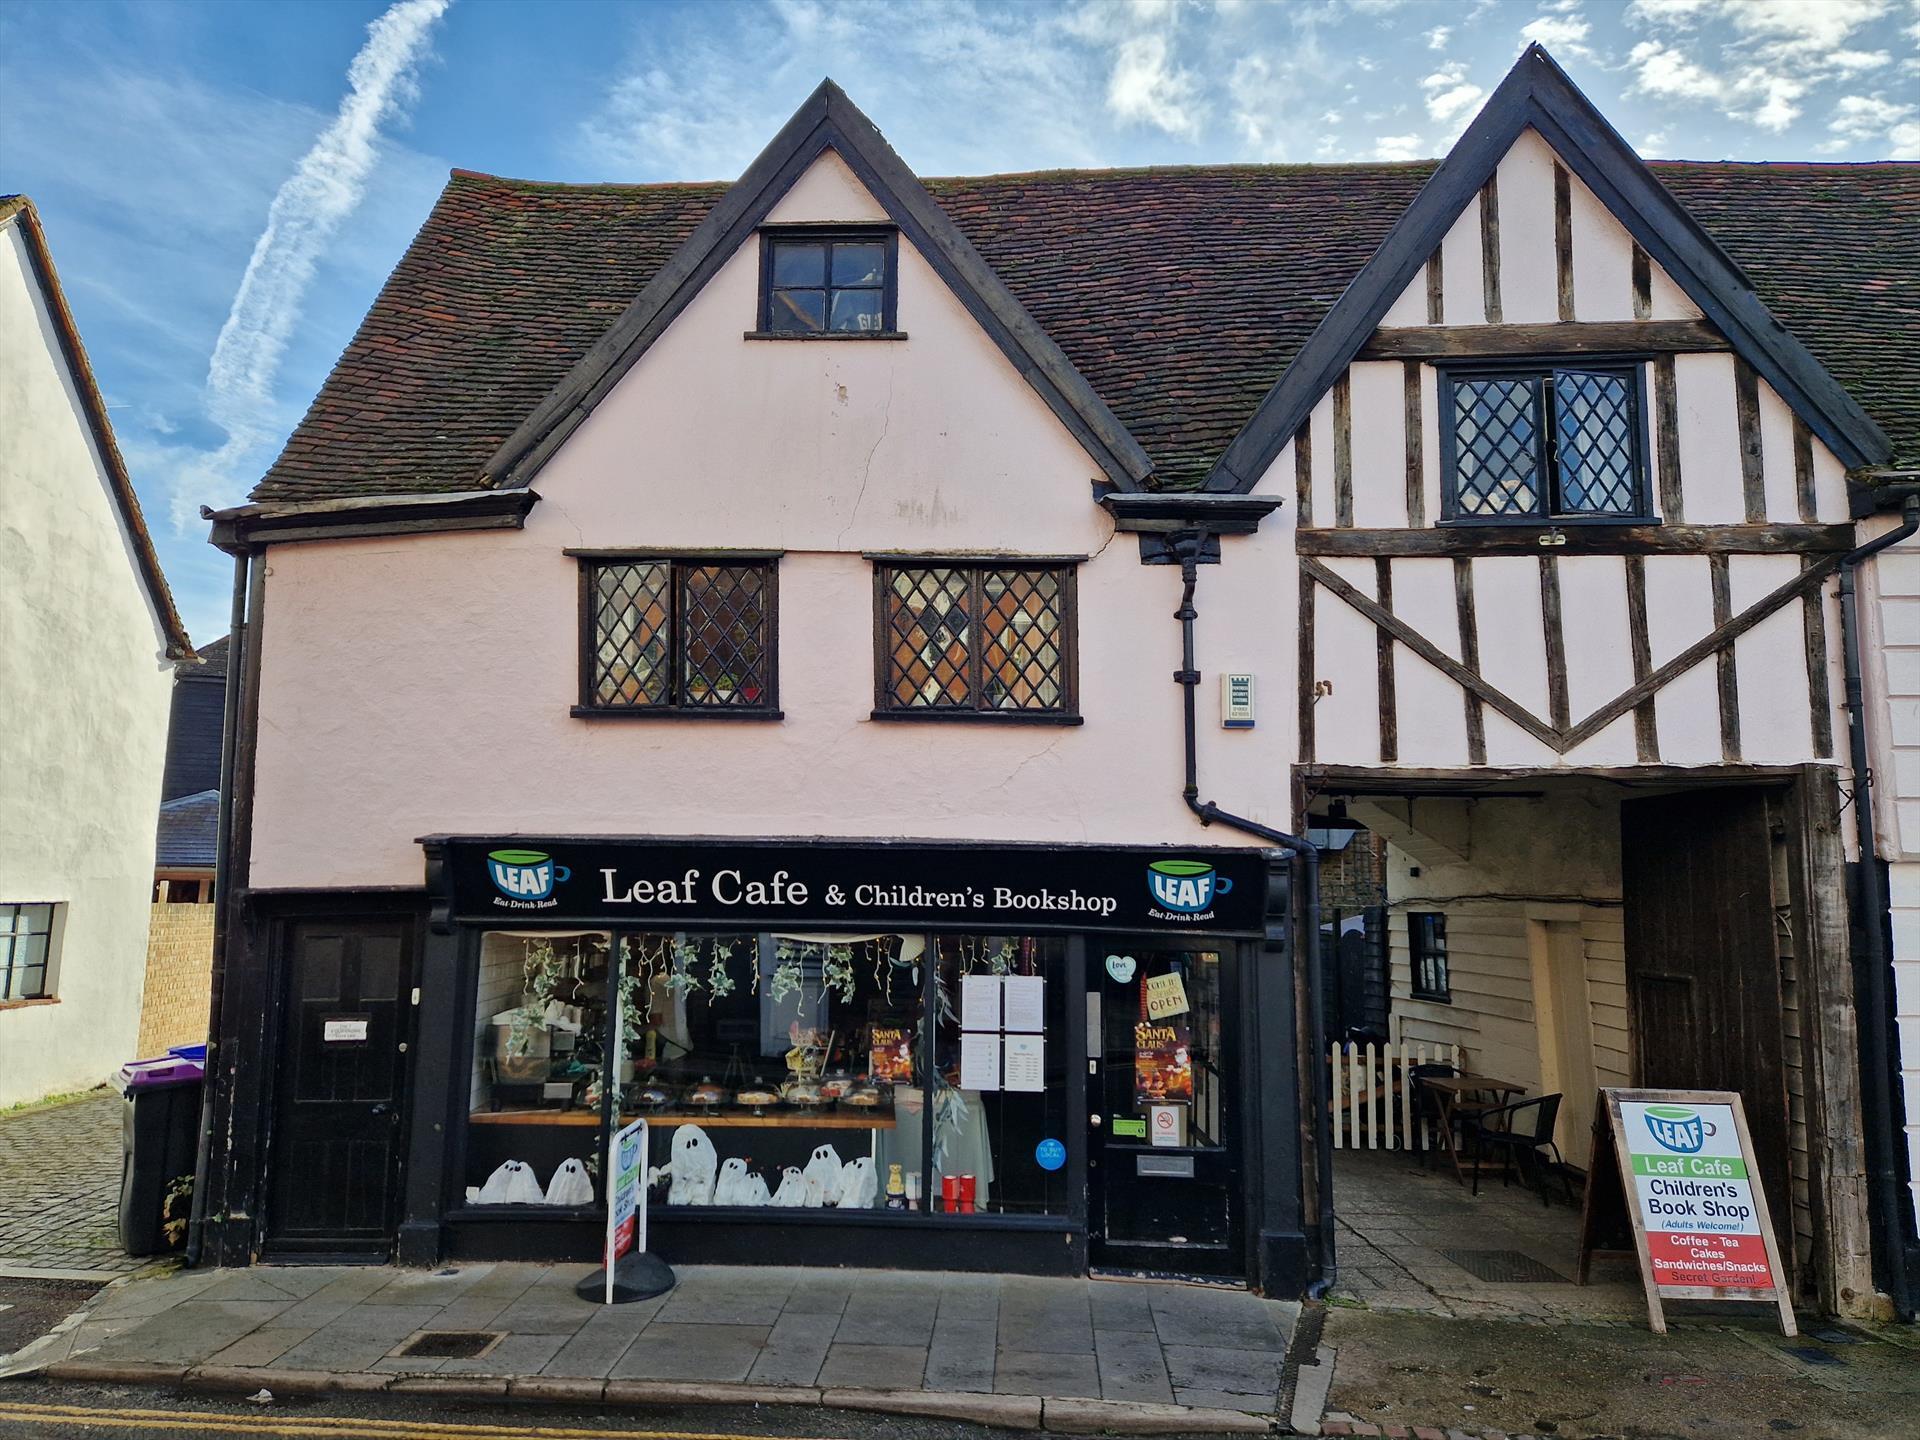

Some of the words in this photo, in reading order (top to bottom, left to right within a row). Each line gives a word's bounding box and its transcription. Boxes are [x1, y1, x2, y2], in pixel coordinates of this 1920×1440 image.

[495, 864, 549, 895] LEAF
[600, 868, 699, 904] Leaf
[712, 869, 808, 905] Cafe
[825, 886, 846, 906] &
[855, 884, 985, 909] Children's
[994, 887, 1117, 917] Bookshop
[1155, 875, 1210, 907] LEAF
[1150, 995, 1183, 1011] OPEN
[872, 1029, 901, 1040] SANTA
[1136, 1027, 1177, 1042] SANTA
[1136, 1040, 1165, 1049] CLAUS
[1651, 1119, 1699, 1149] LEAF
[1645, 1157, 1684, 1174] Leaf
[1691, 1158, 1732, 1176] Cafe
[1651, 1179, 1738, 1198] Children's
[1649, 1199, 1697, 1216] Book
[1703, 1200, 1750, 1221] Shop
[1662, 1221, 1694, 1230] (Adults
[1696, 1221, 1744, 1232] Welcome!)
[1671, 1235, 1709, 1247] Coffee
[1721, 1237, 1739, 1248] Tea
[1690, 1248, 1725, 1259] Cakes
[1671, 1272, 1708, 1283] Secret
